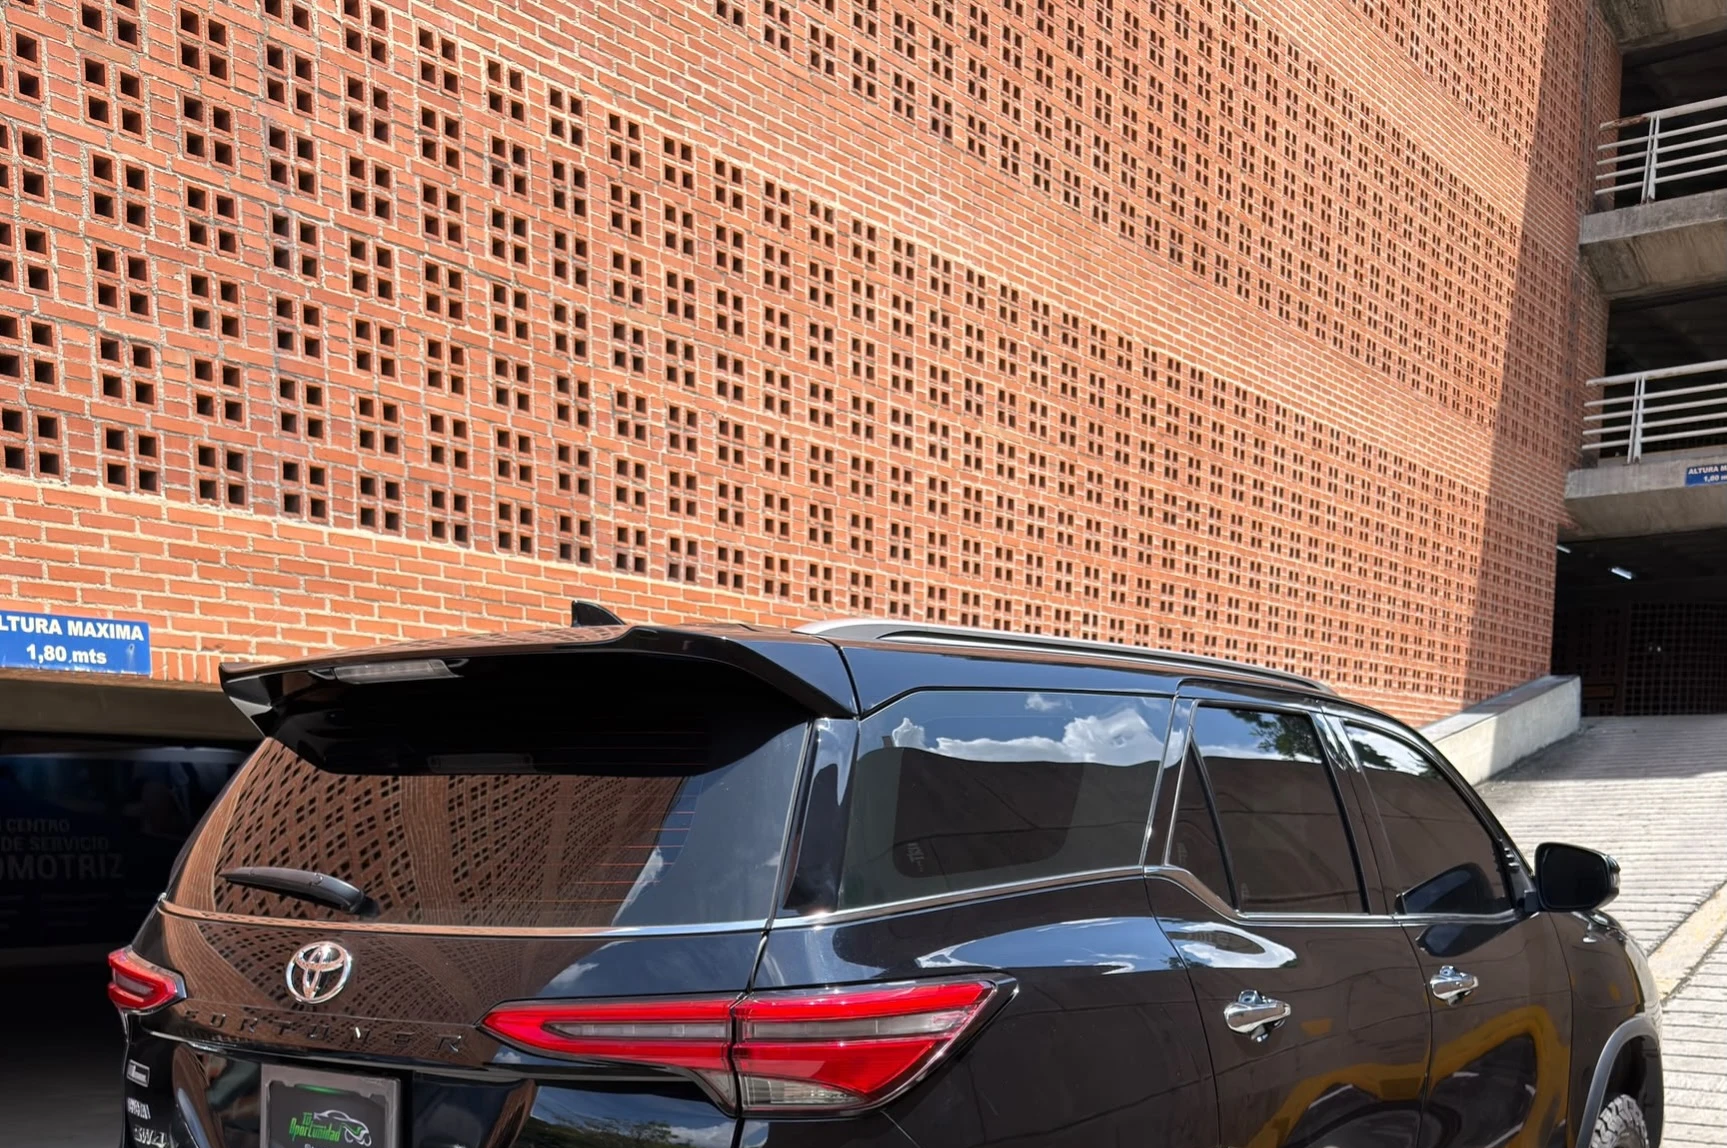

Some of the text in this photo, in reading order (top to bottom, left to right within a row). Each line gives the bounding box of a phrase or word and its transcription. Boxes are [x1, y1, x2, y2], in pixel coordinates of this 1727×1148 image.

[1688, 465, 1719, 475] ALTURA
[67, 620, 145, 641] MAXIMA
[26, 643, 107, 664] 1,80 mts
[183, 1009, 463, 1052] FORTUNER
